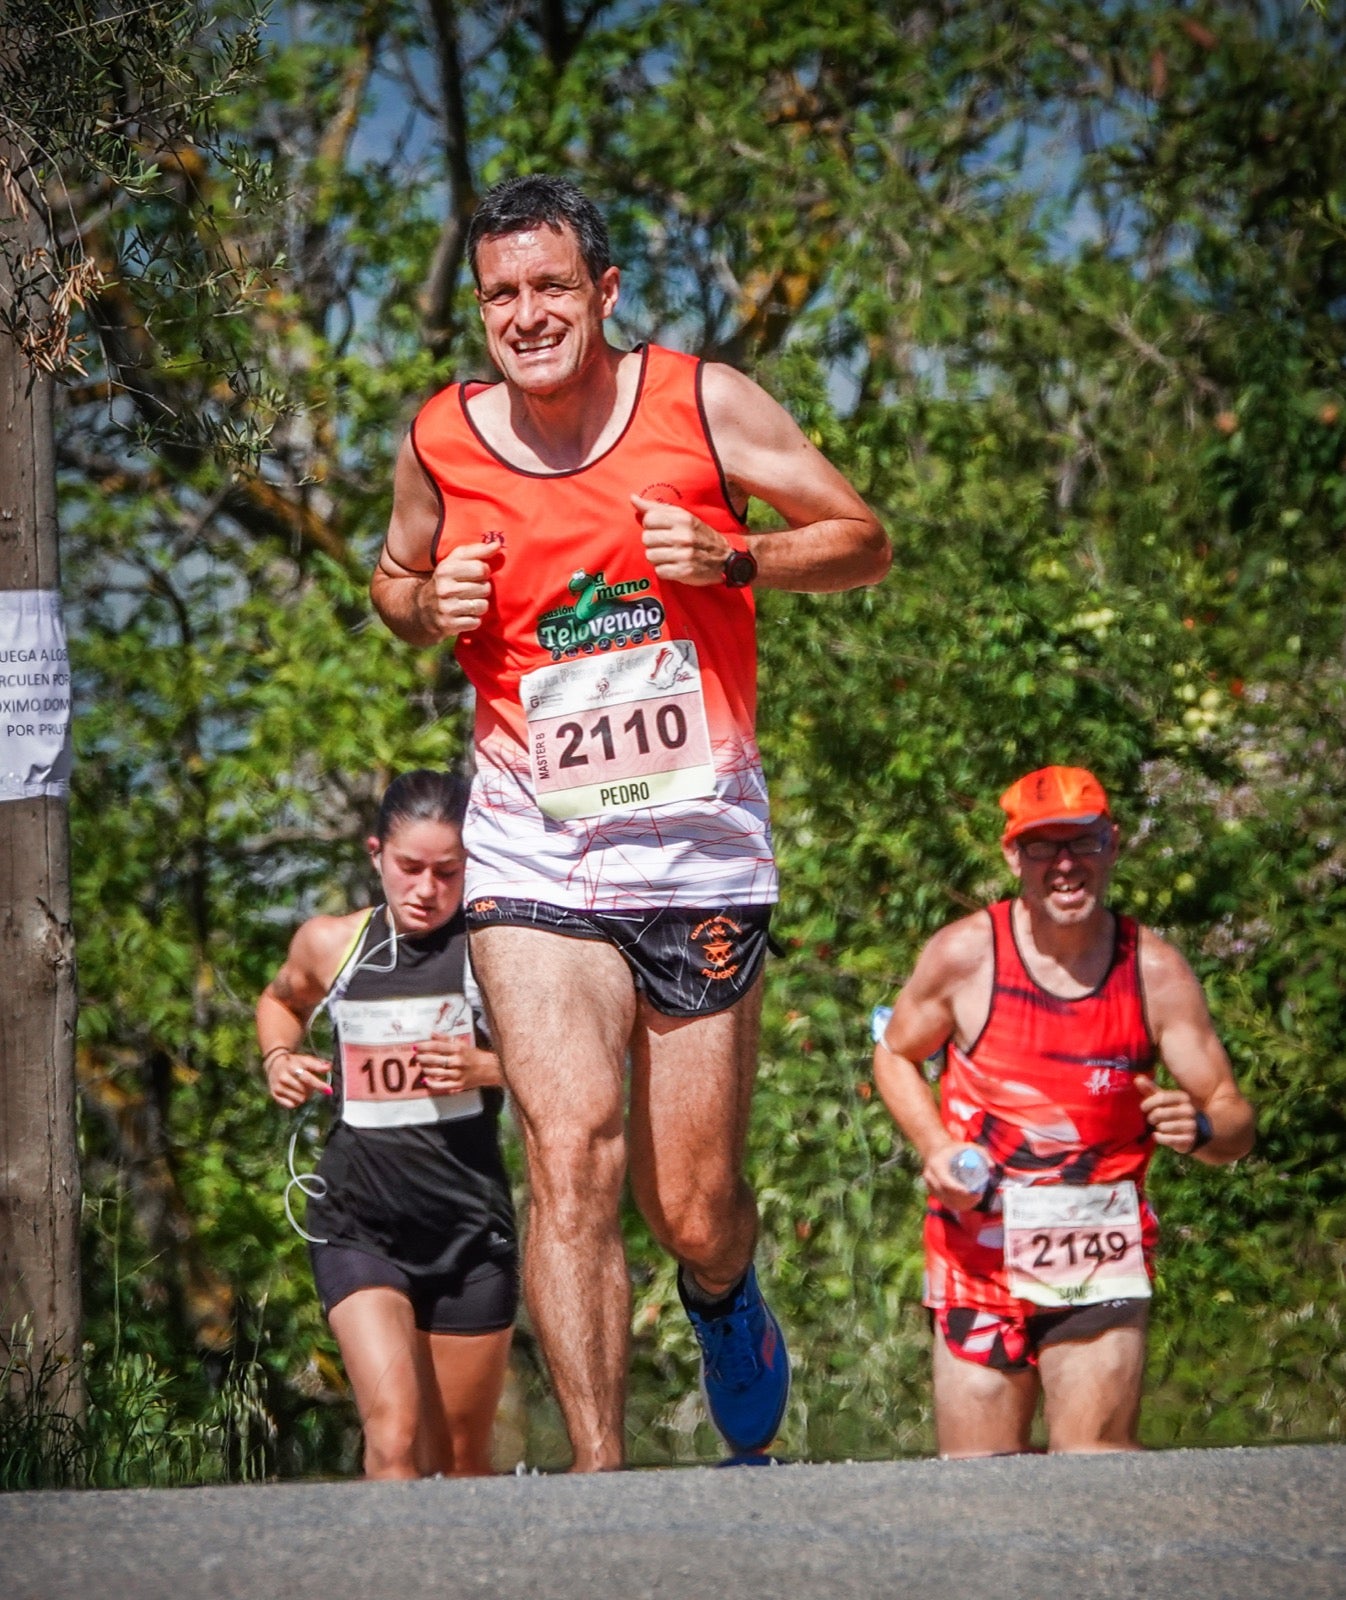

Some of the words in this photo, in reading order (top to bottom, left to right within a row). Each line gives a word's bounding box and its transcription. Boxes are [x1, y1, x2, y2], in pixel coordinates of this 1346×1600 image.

[595, 571, 606, 585] a
[596, 578, 651, 601] mano
[0, 648, 37, 663] UEGA
[40, 648, 49, 662] A
[7, 724, 35, 737] POR
[536, 732, 546, 742] B
[555, 703, 688, 770] 2110
[535, 742, 551, 780] MASTER
[600, 781, 650, 807] PEDRO
[1031, 1231, 1128, 1269] 2149
